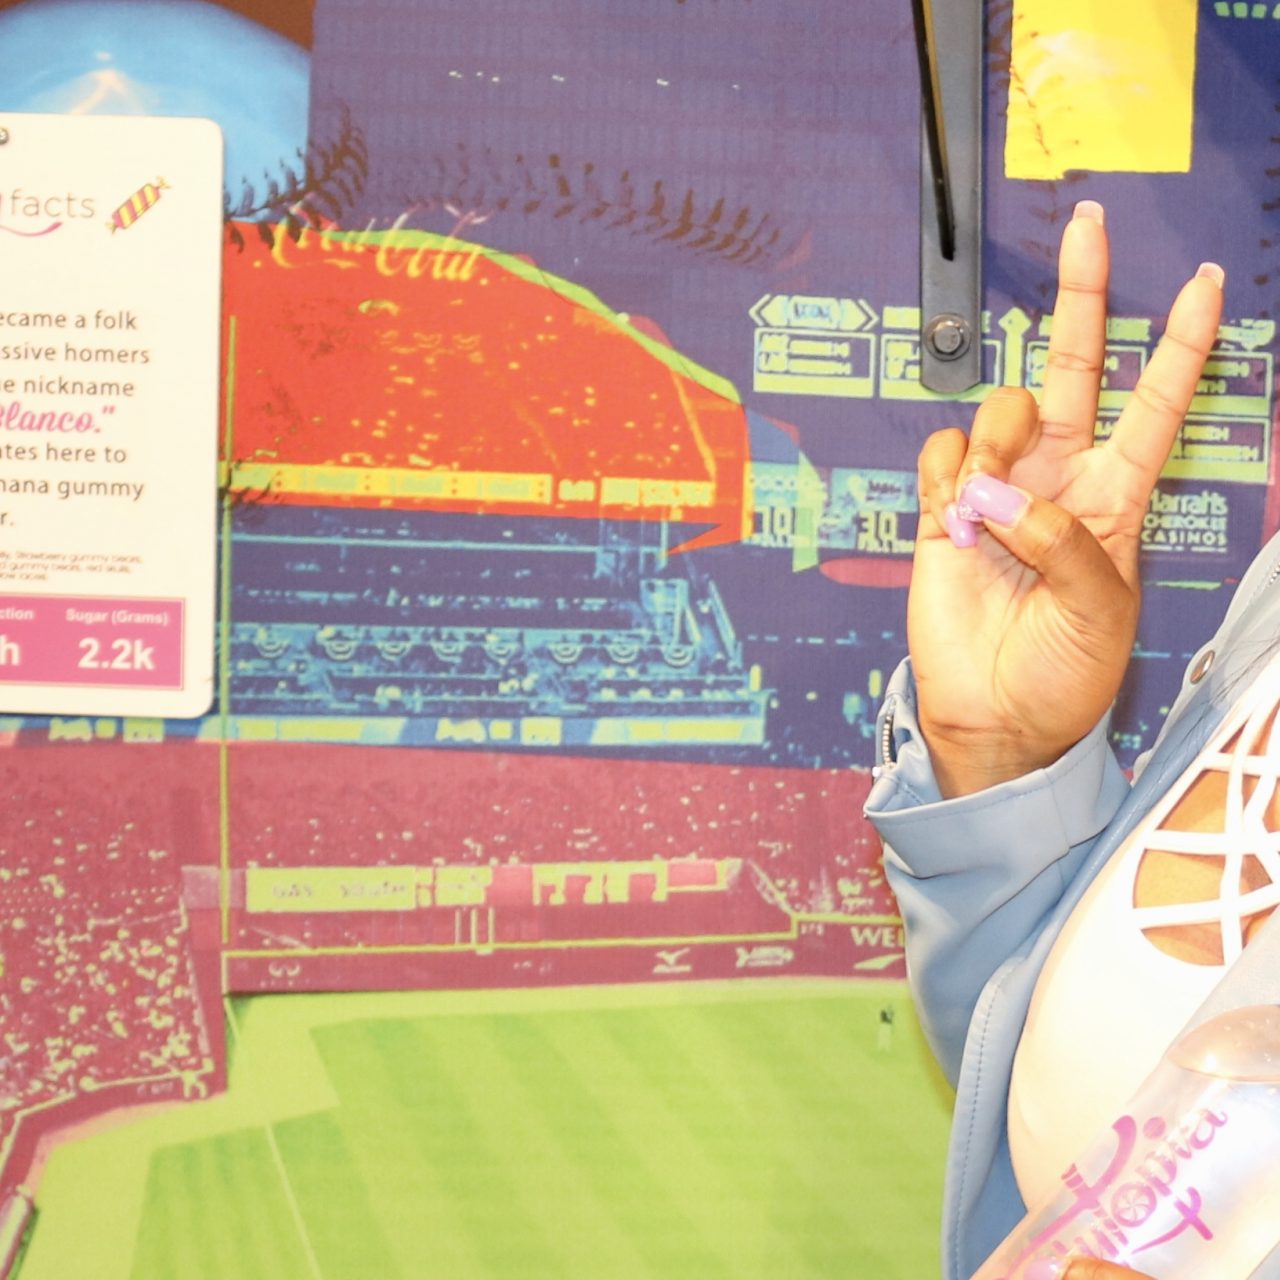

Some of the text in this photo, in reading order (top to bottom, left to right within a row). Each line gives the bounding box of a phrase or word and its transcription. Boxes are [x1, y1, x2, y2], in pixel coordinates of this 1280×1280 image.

[10, 188, 96, 219] facts
[74, 314, 87, 329] a
[95, 309, 138, 330] folk
[65, 342, 151, 364] homers
[24, 375, 135, 397] nickname
[46, 442, 97, 463] here
[105, 446, 128, 464] to
[57, 480, 145, 502] gummy
[1141, 529, 1227, 547] CASINOS
[65, 608, 108, 624] Sugar
[111, 609, 169, 626] (Grams)
[77, 636, 156, 671] 2.2k
